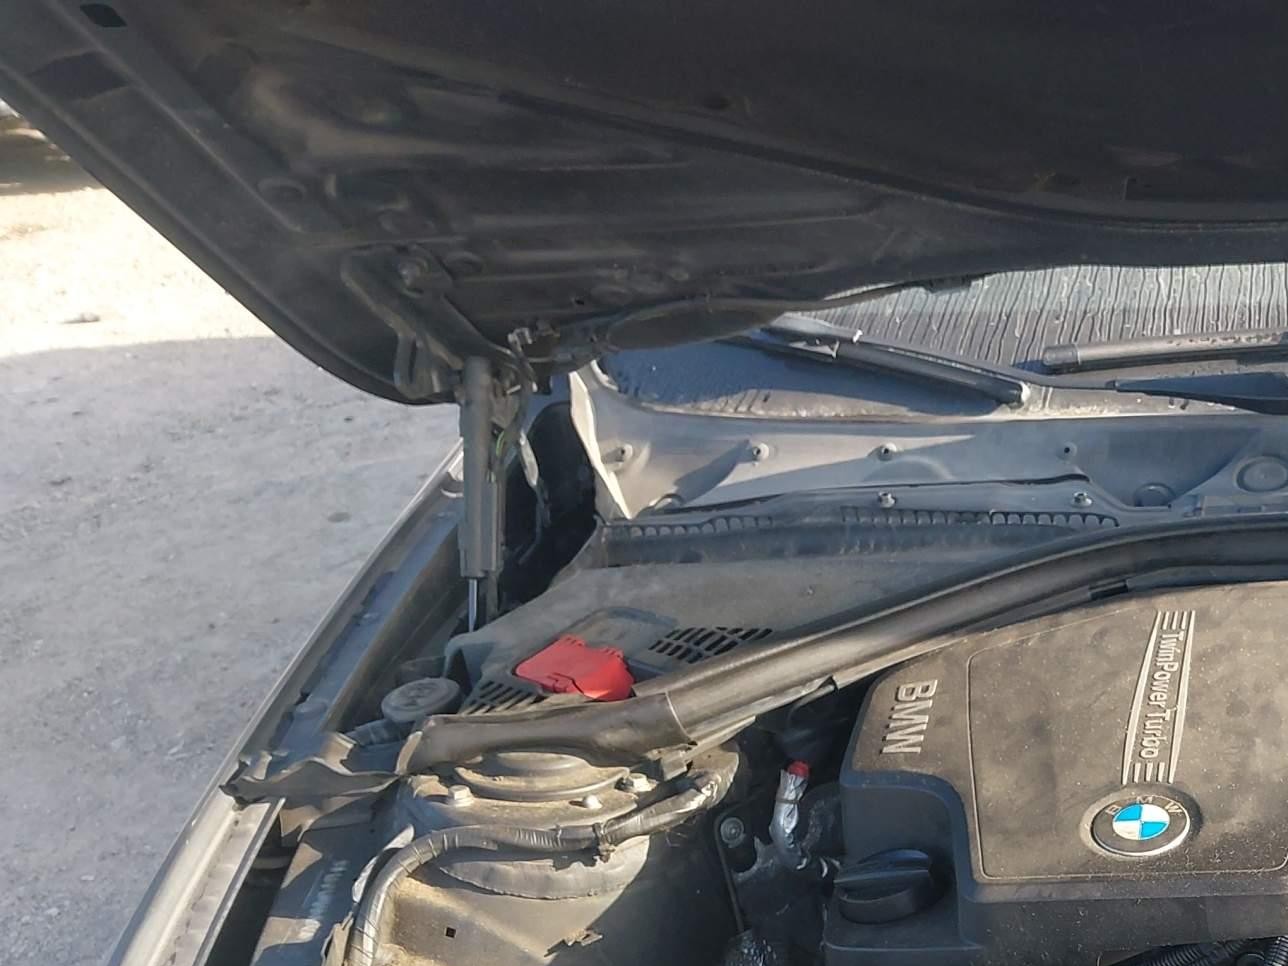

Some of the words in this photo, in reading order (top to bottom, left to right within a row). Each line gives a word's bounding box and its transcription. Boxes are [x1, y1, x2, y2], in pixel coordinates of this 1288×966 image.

[1148, 630, 1185, 708] TwinPower
[881, 679, 938, 754] BMW
[1139, 707, 1172, 759] Turbo
[1105, 796, 1183, 816] BMW
